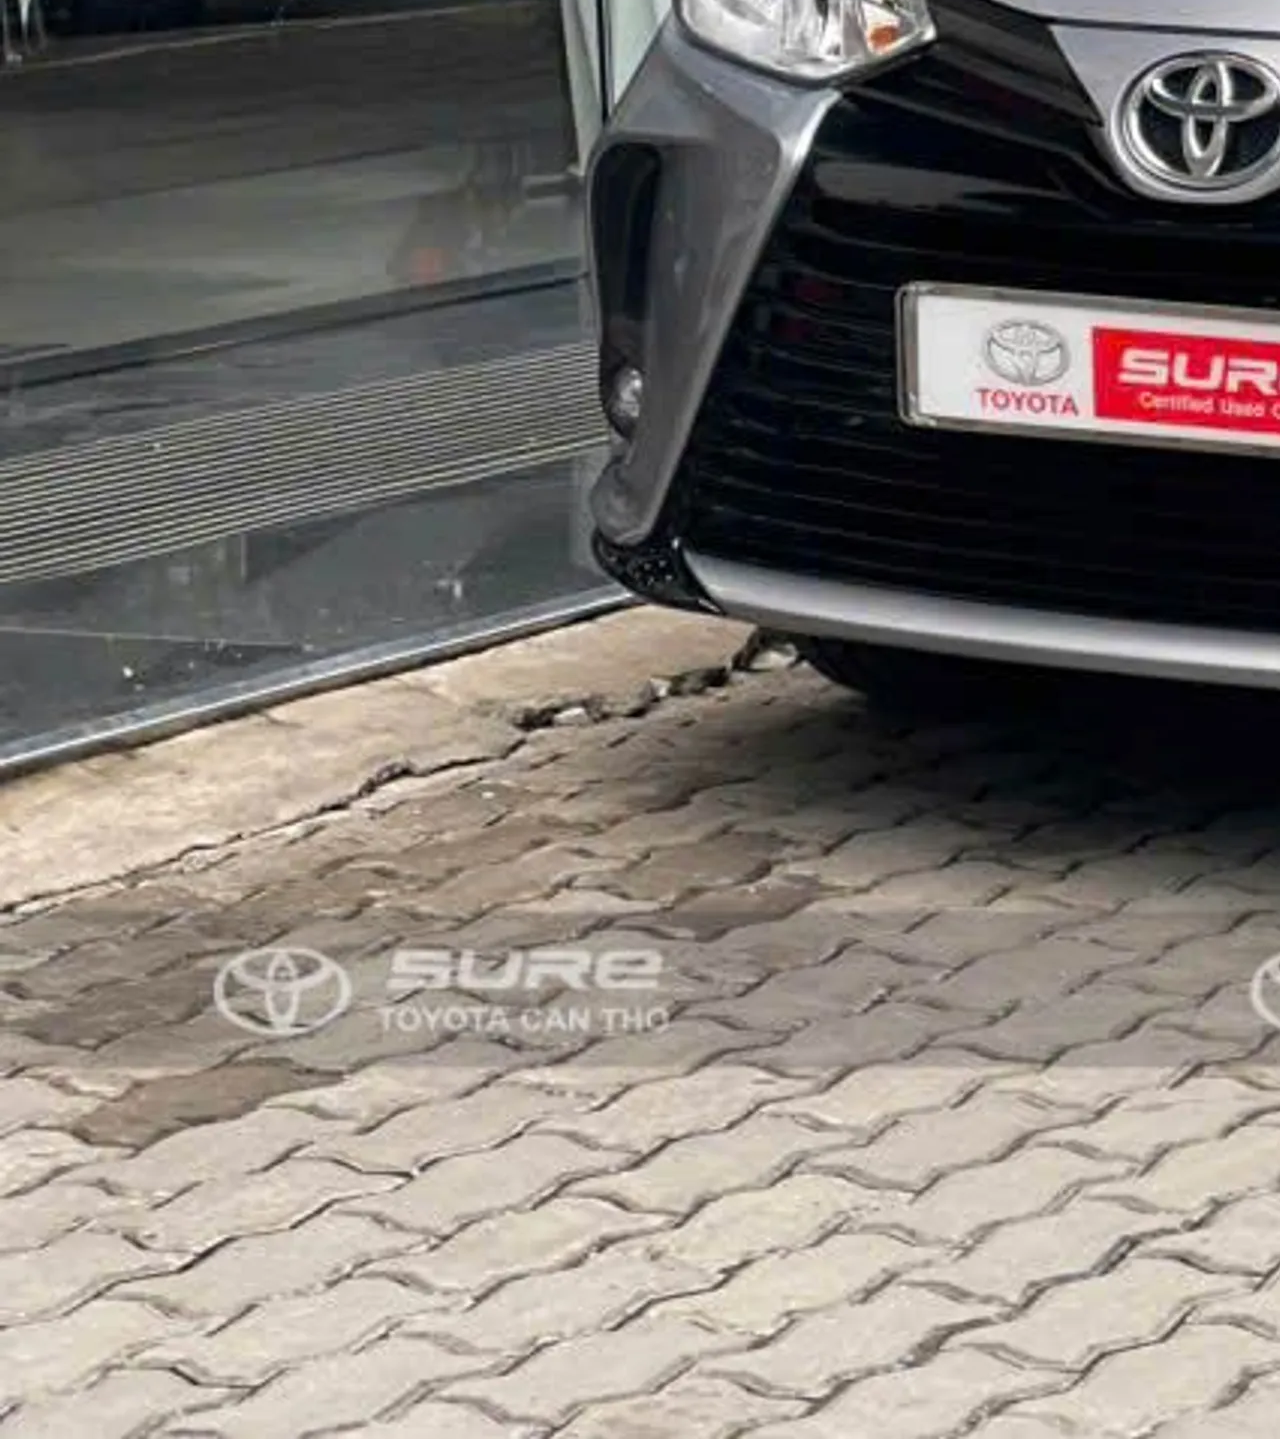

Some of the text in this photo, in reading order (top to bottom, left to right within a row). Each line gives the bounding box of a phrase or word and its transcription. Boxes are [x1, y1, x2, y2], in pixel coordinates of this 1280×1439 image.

[974, 387, 1080, 417] TOYOTA
[1140, 391, 1215, 415] Certified
[1220, 398, 1265, 418] Used
